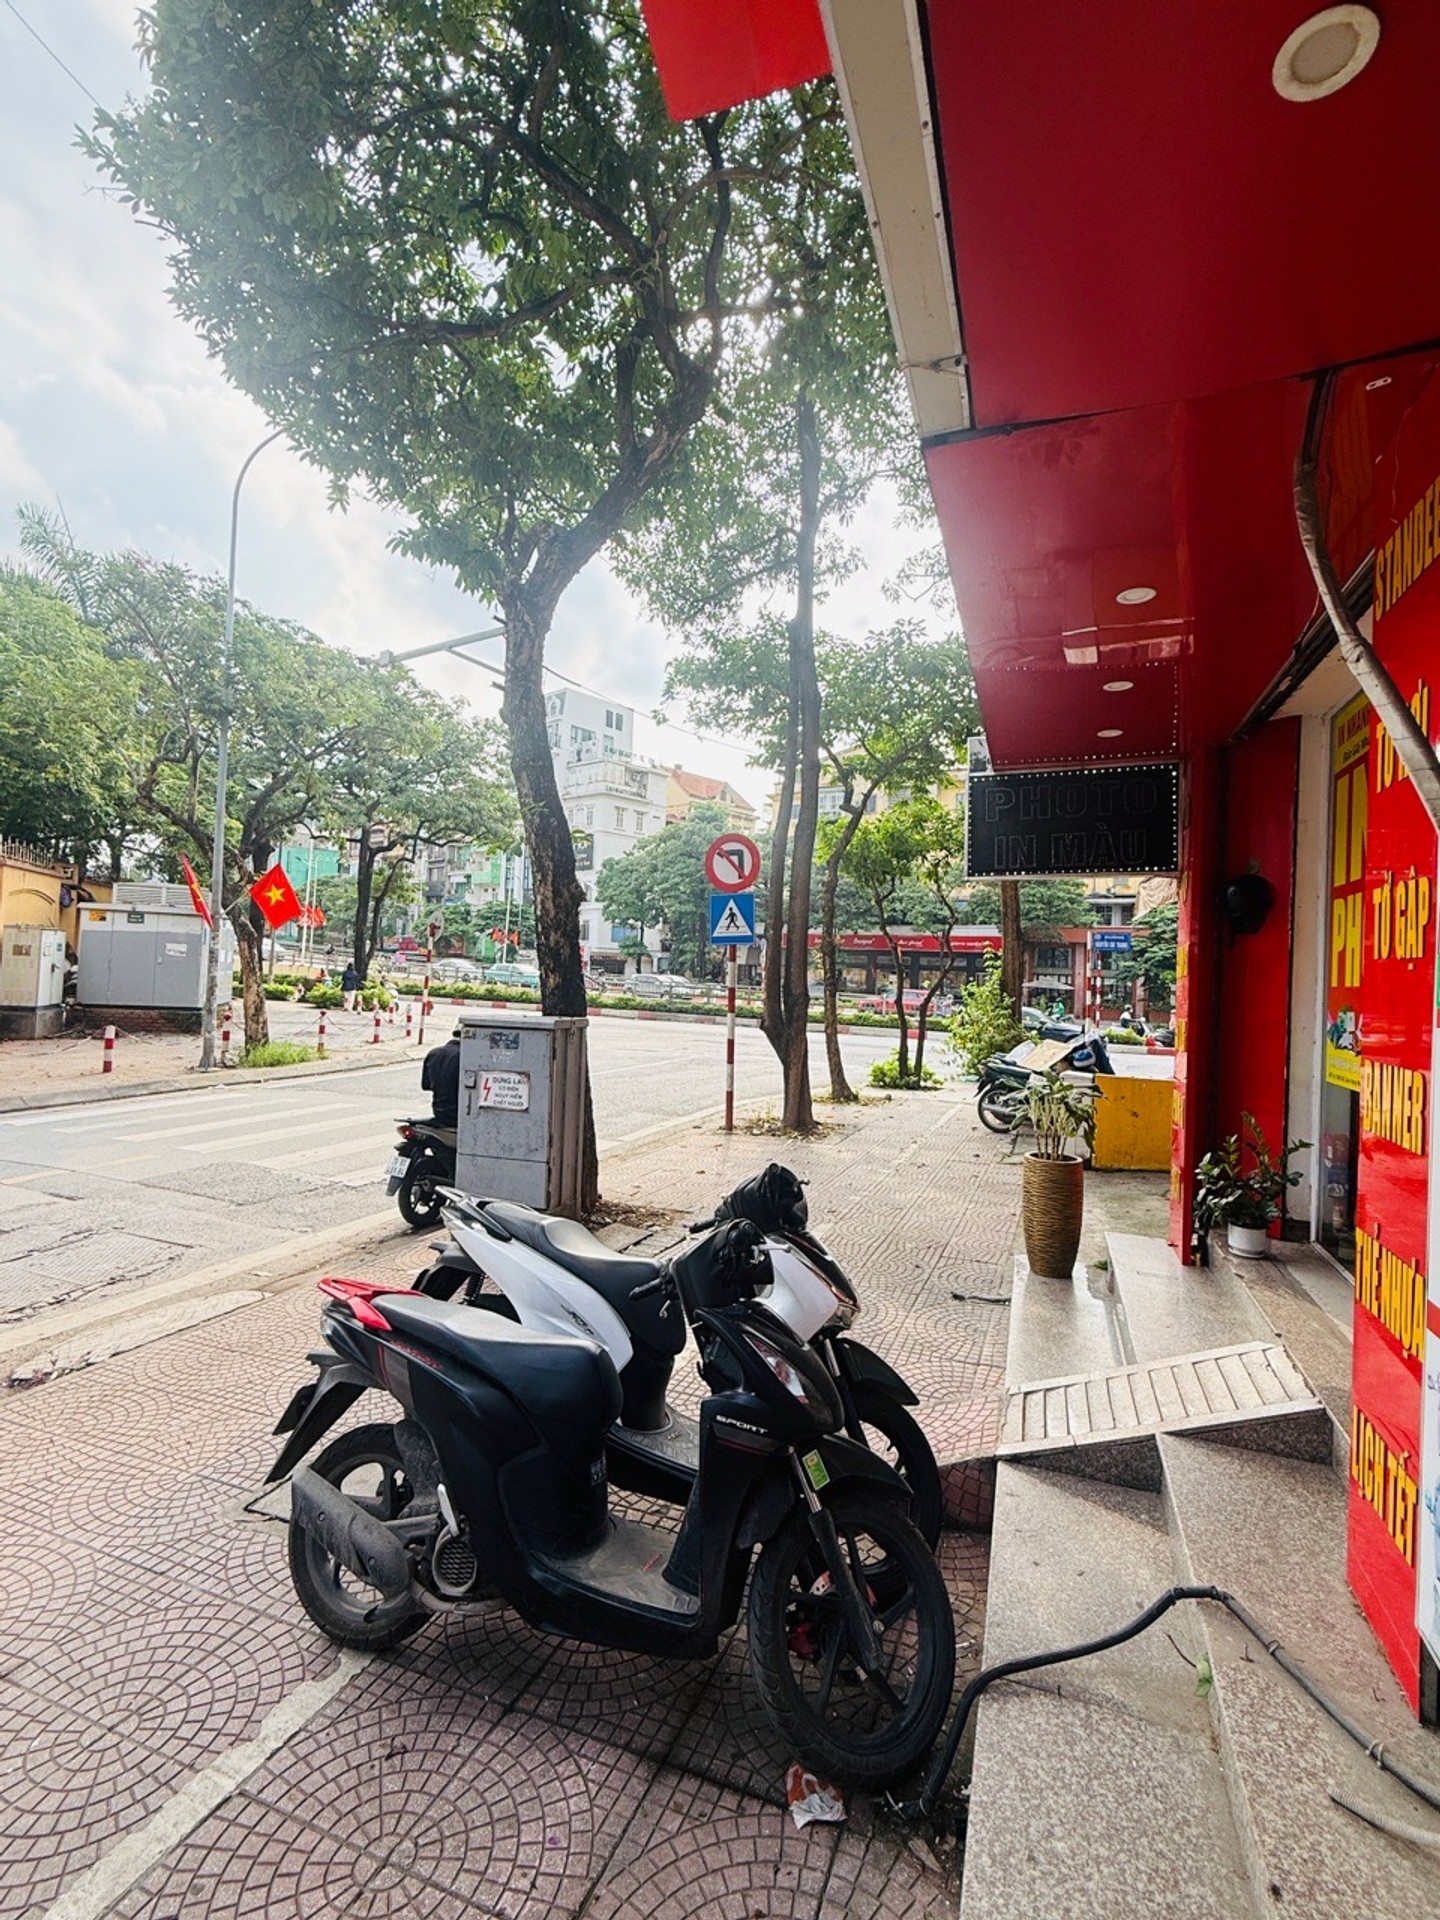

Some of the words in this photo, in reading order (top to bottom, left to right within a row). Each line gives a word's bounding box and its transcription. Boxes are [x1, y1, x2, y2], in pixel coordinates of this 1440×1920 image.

[985, 777, 1157, 822] PHOTO
[995, 834, 1036, 869] IN
[1051, 820, 1147, 866] MÀU
[1362, 1059, 1424, 1156] BANNER
[716, 1415, 768, 1434] SPORT
